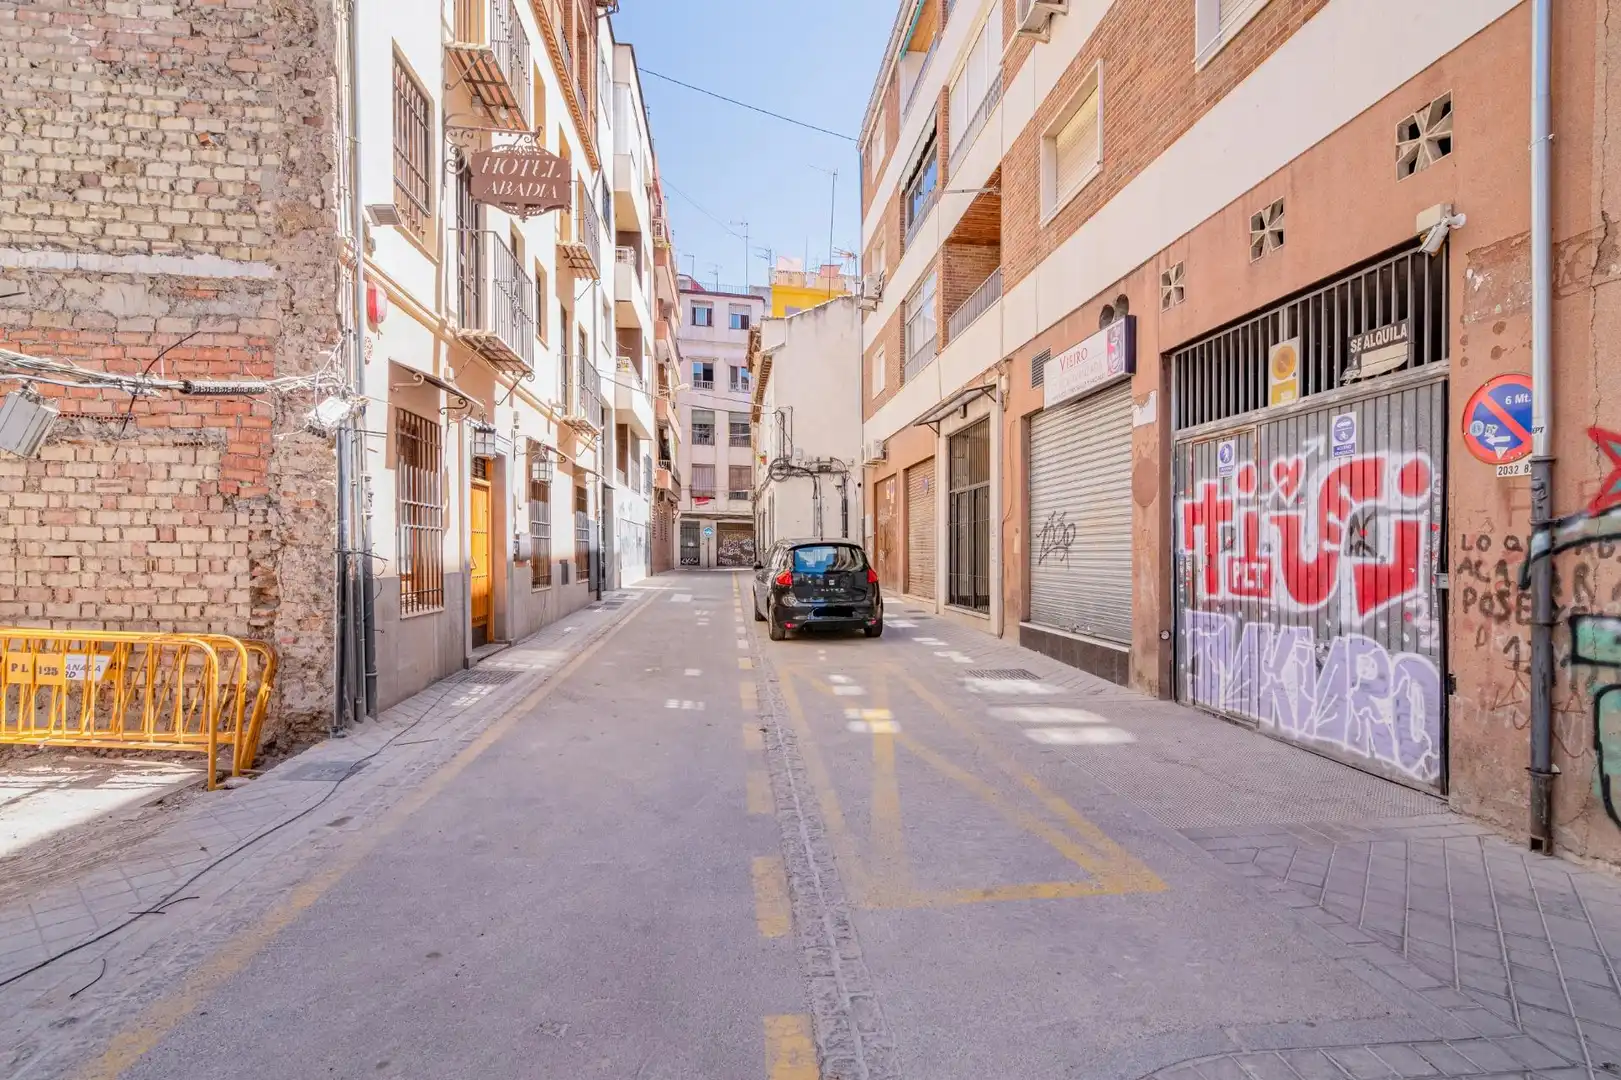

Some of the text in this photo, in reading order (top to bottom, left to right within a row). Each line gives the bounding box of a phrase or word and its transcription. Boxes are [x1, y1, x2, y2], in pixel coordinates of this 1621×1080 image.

[481, 156, 561, 178] HOTEL
[484, 180, 558, 199] ABADIA
[1350, 323, 1408, 353] SE ALQUILA
[1505, 395, 1512, 405] 6
[1498, 465, 1519, 476] 2032
